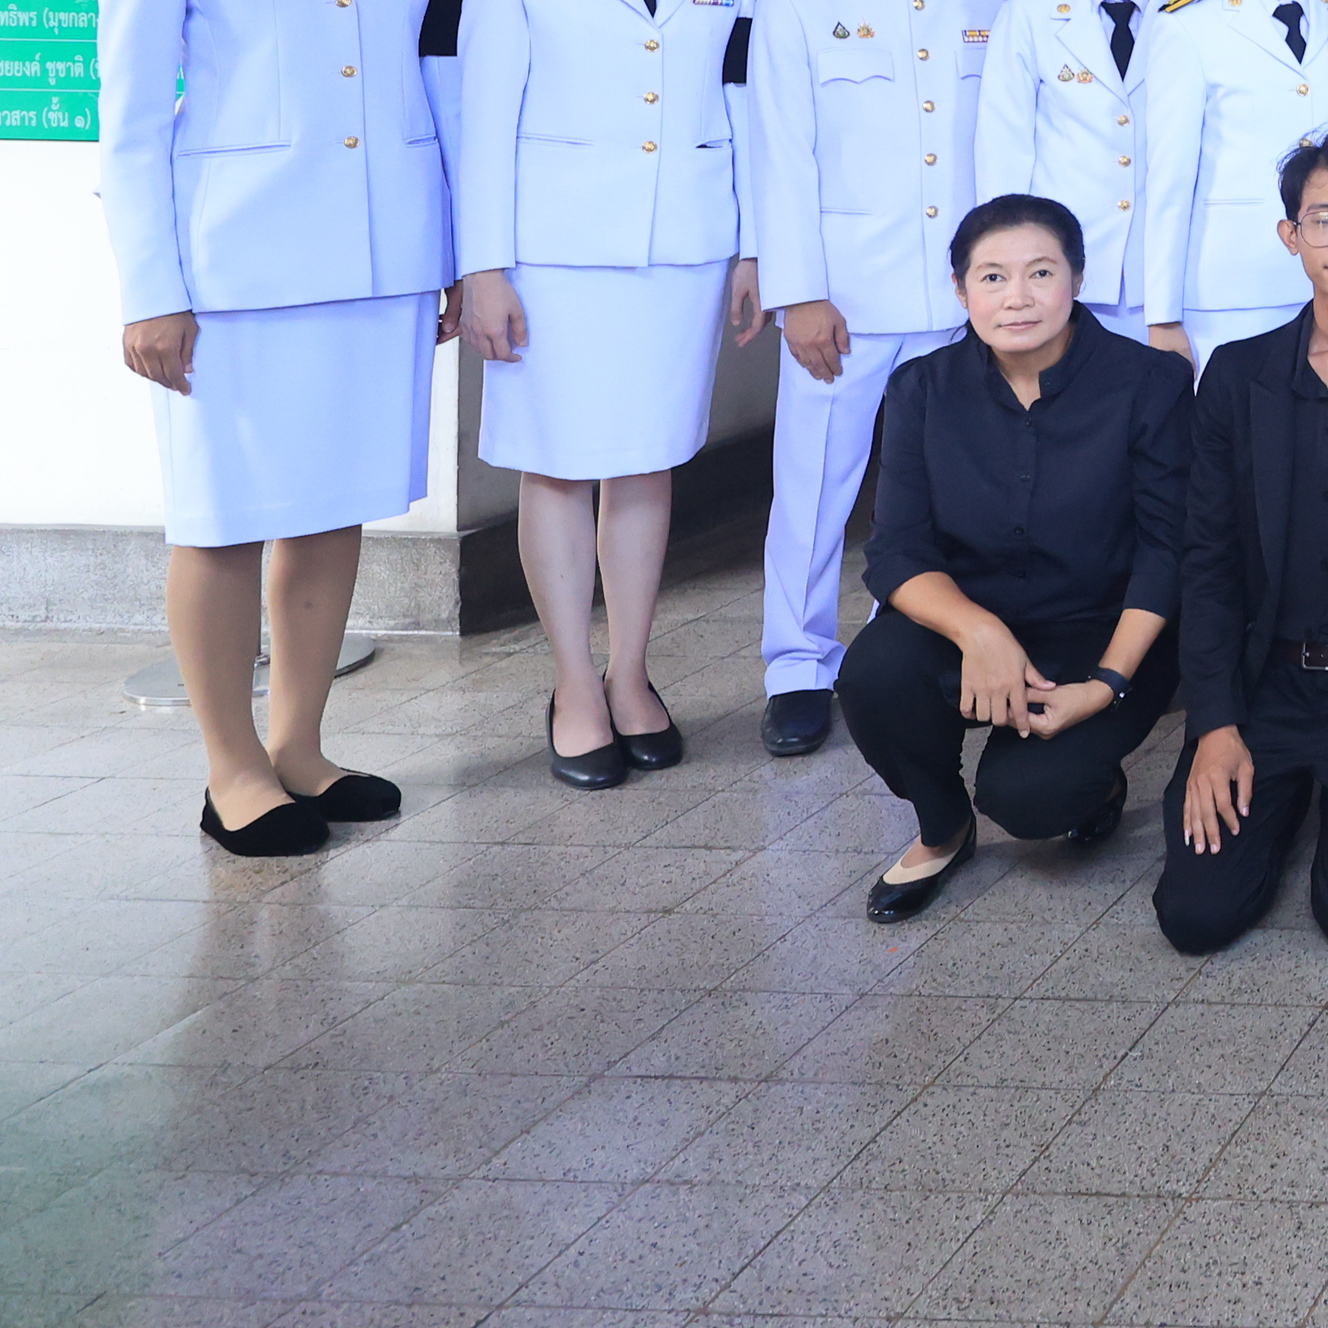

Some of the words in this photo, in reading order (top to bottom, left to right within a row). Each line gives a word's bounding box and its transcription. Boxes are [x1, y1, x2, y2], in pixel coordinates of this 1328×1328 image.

[45, 54, 84, 86] ชูชาติ
[0, 109, 37, 127] วสาร
